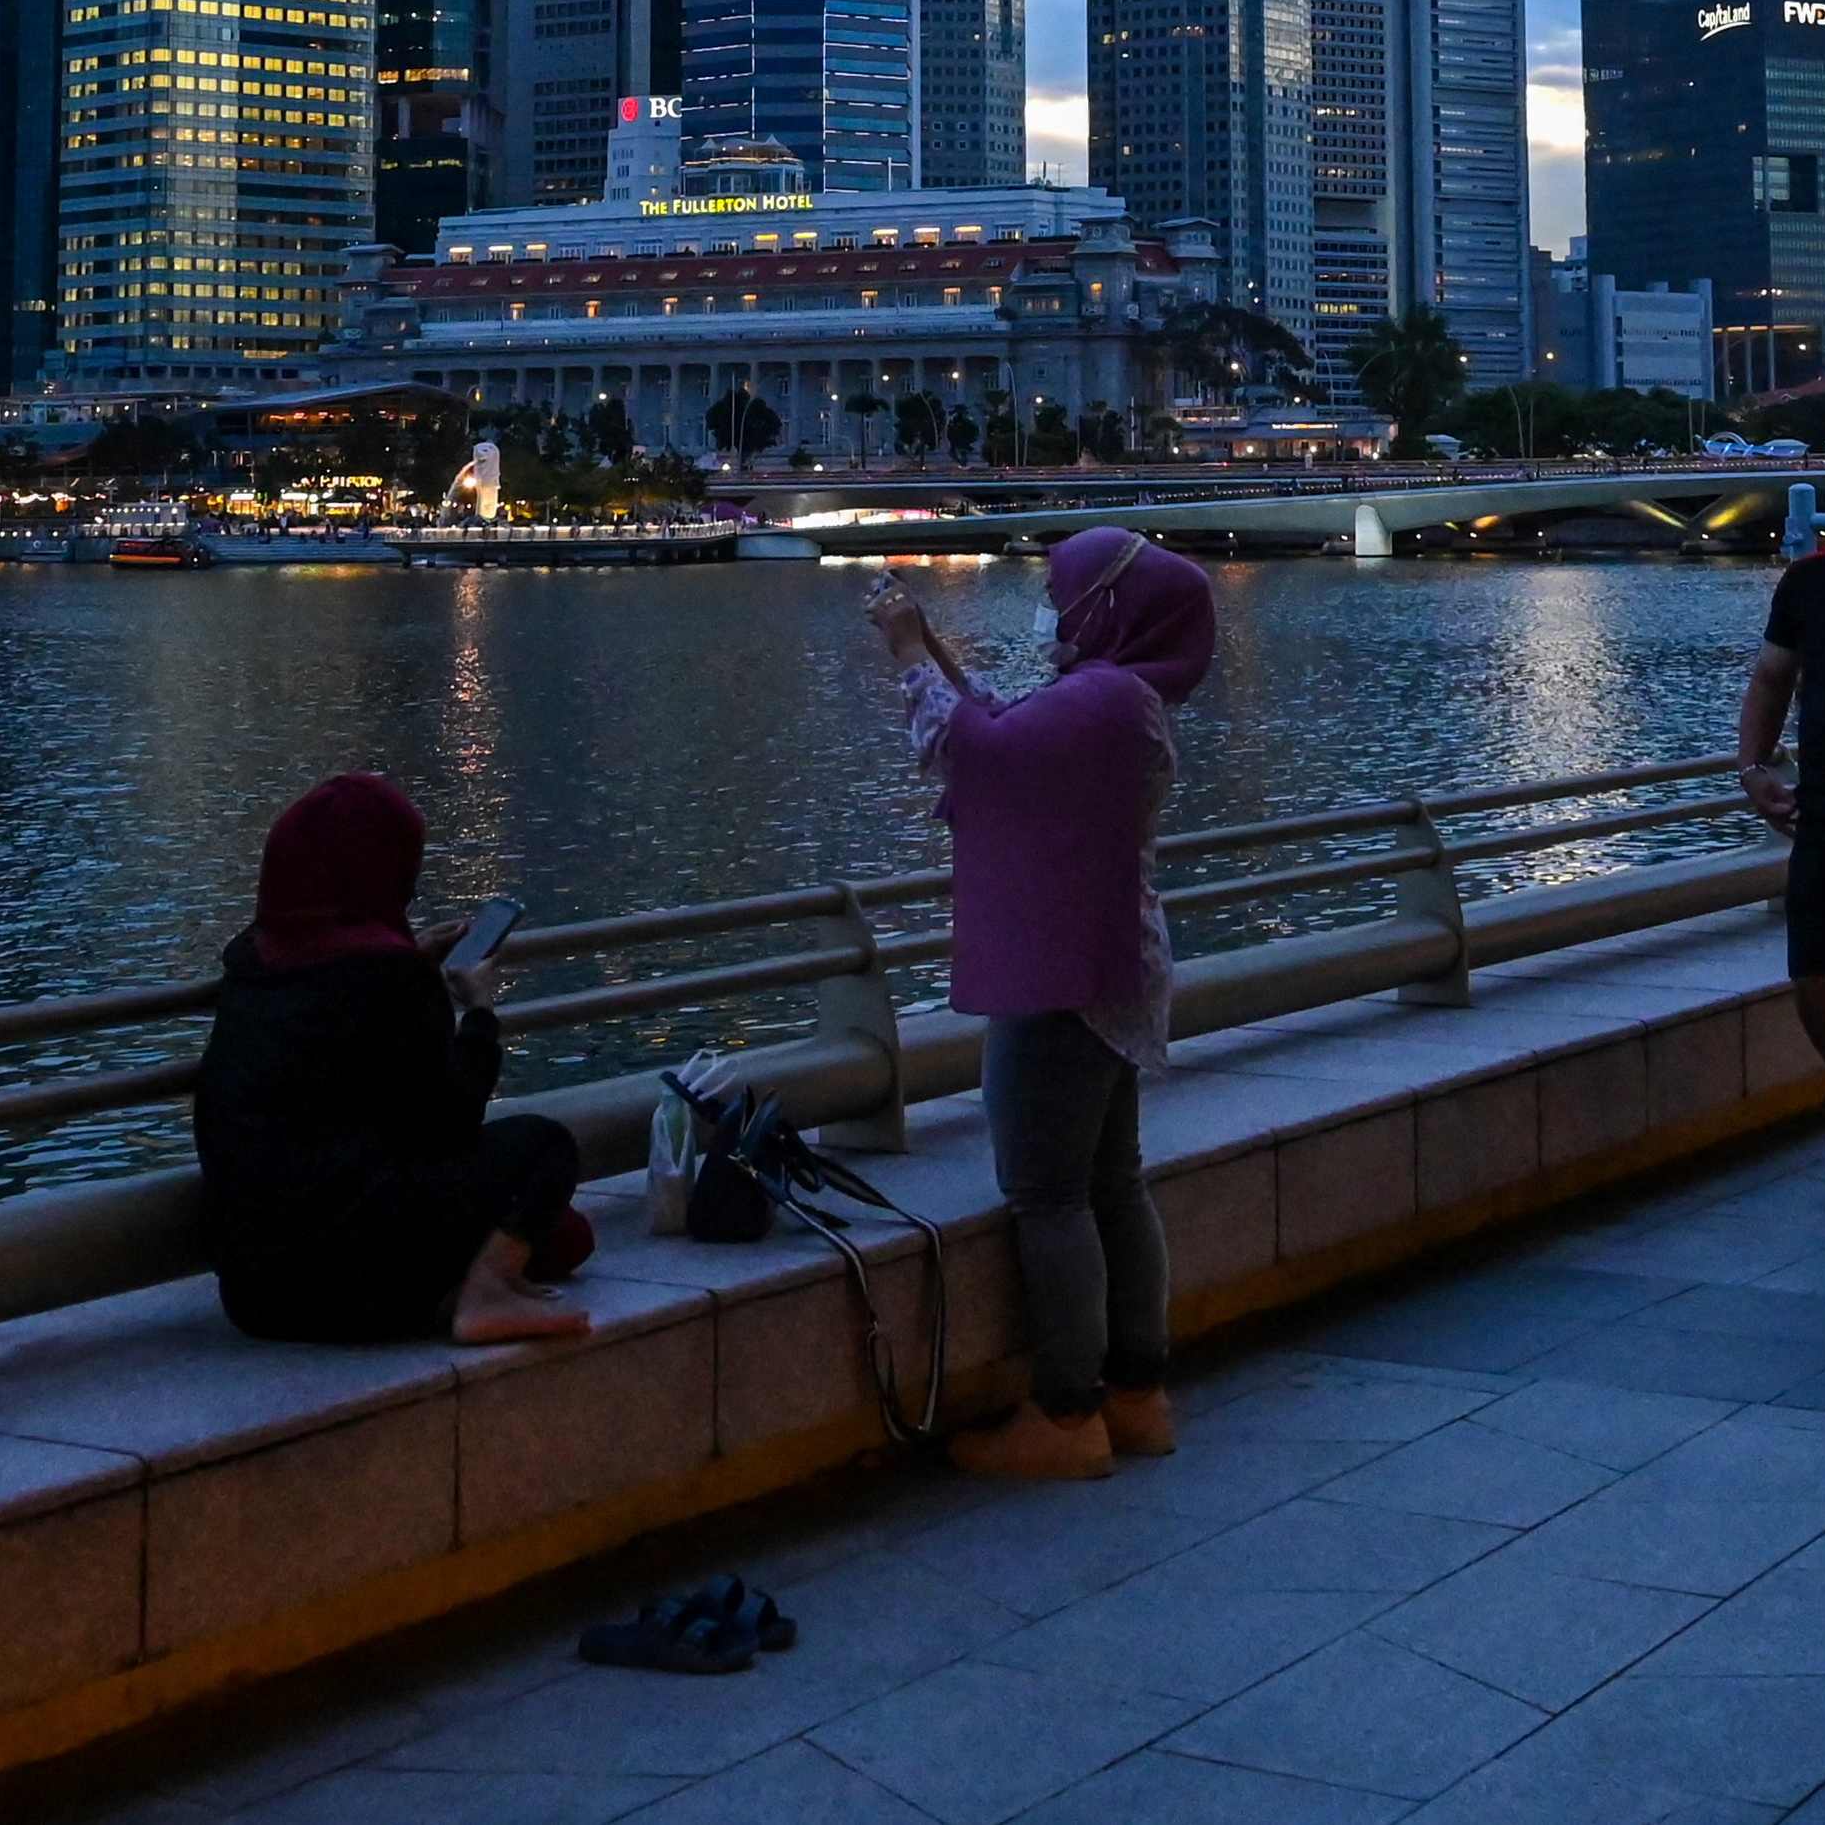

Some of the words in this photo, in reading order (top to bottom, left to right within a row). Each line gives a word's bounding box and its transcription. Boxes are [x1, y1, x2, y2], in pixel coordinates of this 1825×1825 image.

[1697, 1, 1751, 31] CapitaLand
[639, 200, 668, 215] THE
[672, 197, 757, 214] FULLERTON
[762, 194, 813, 210] HOTEL
